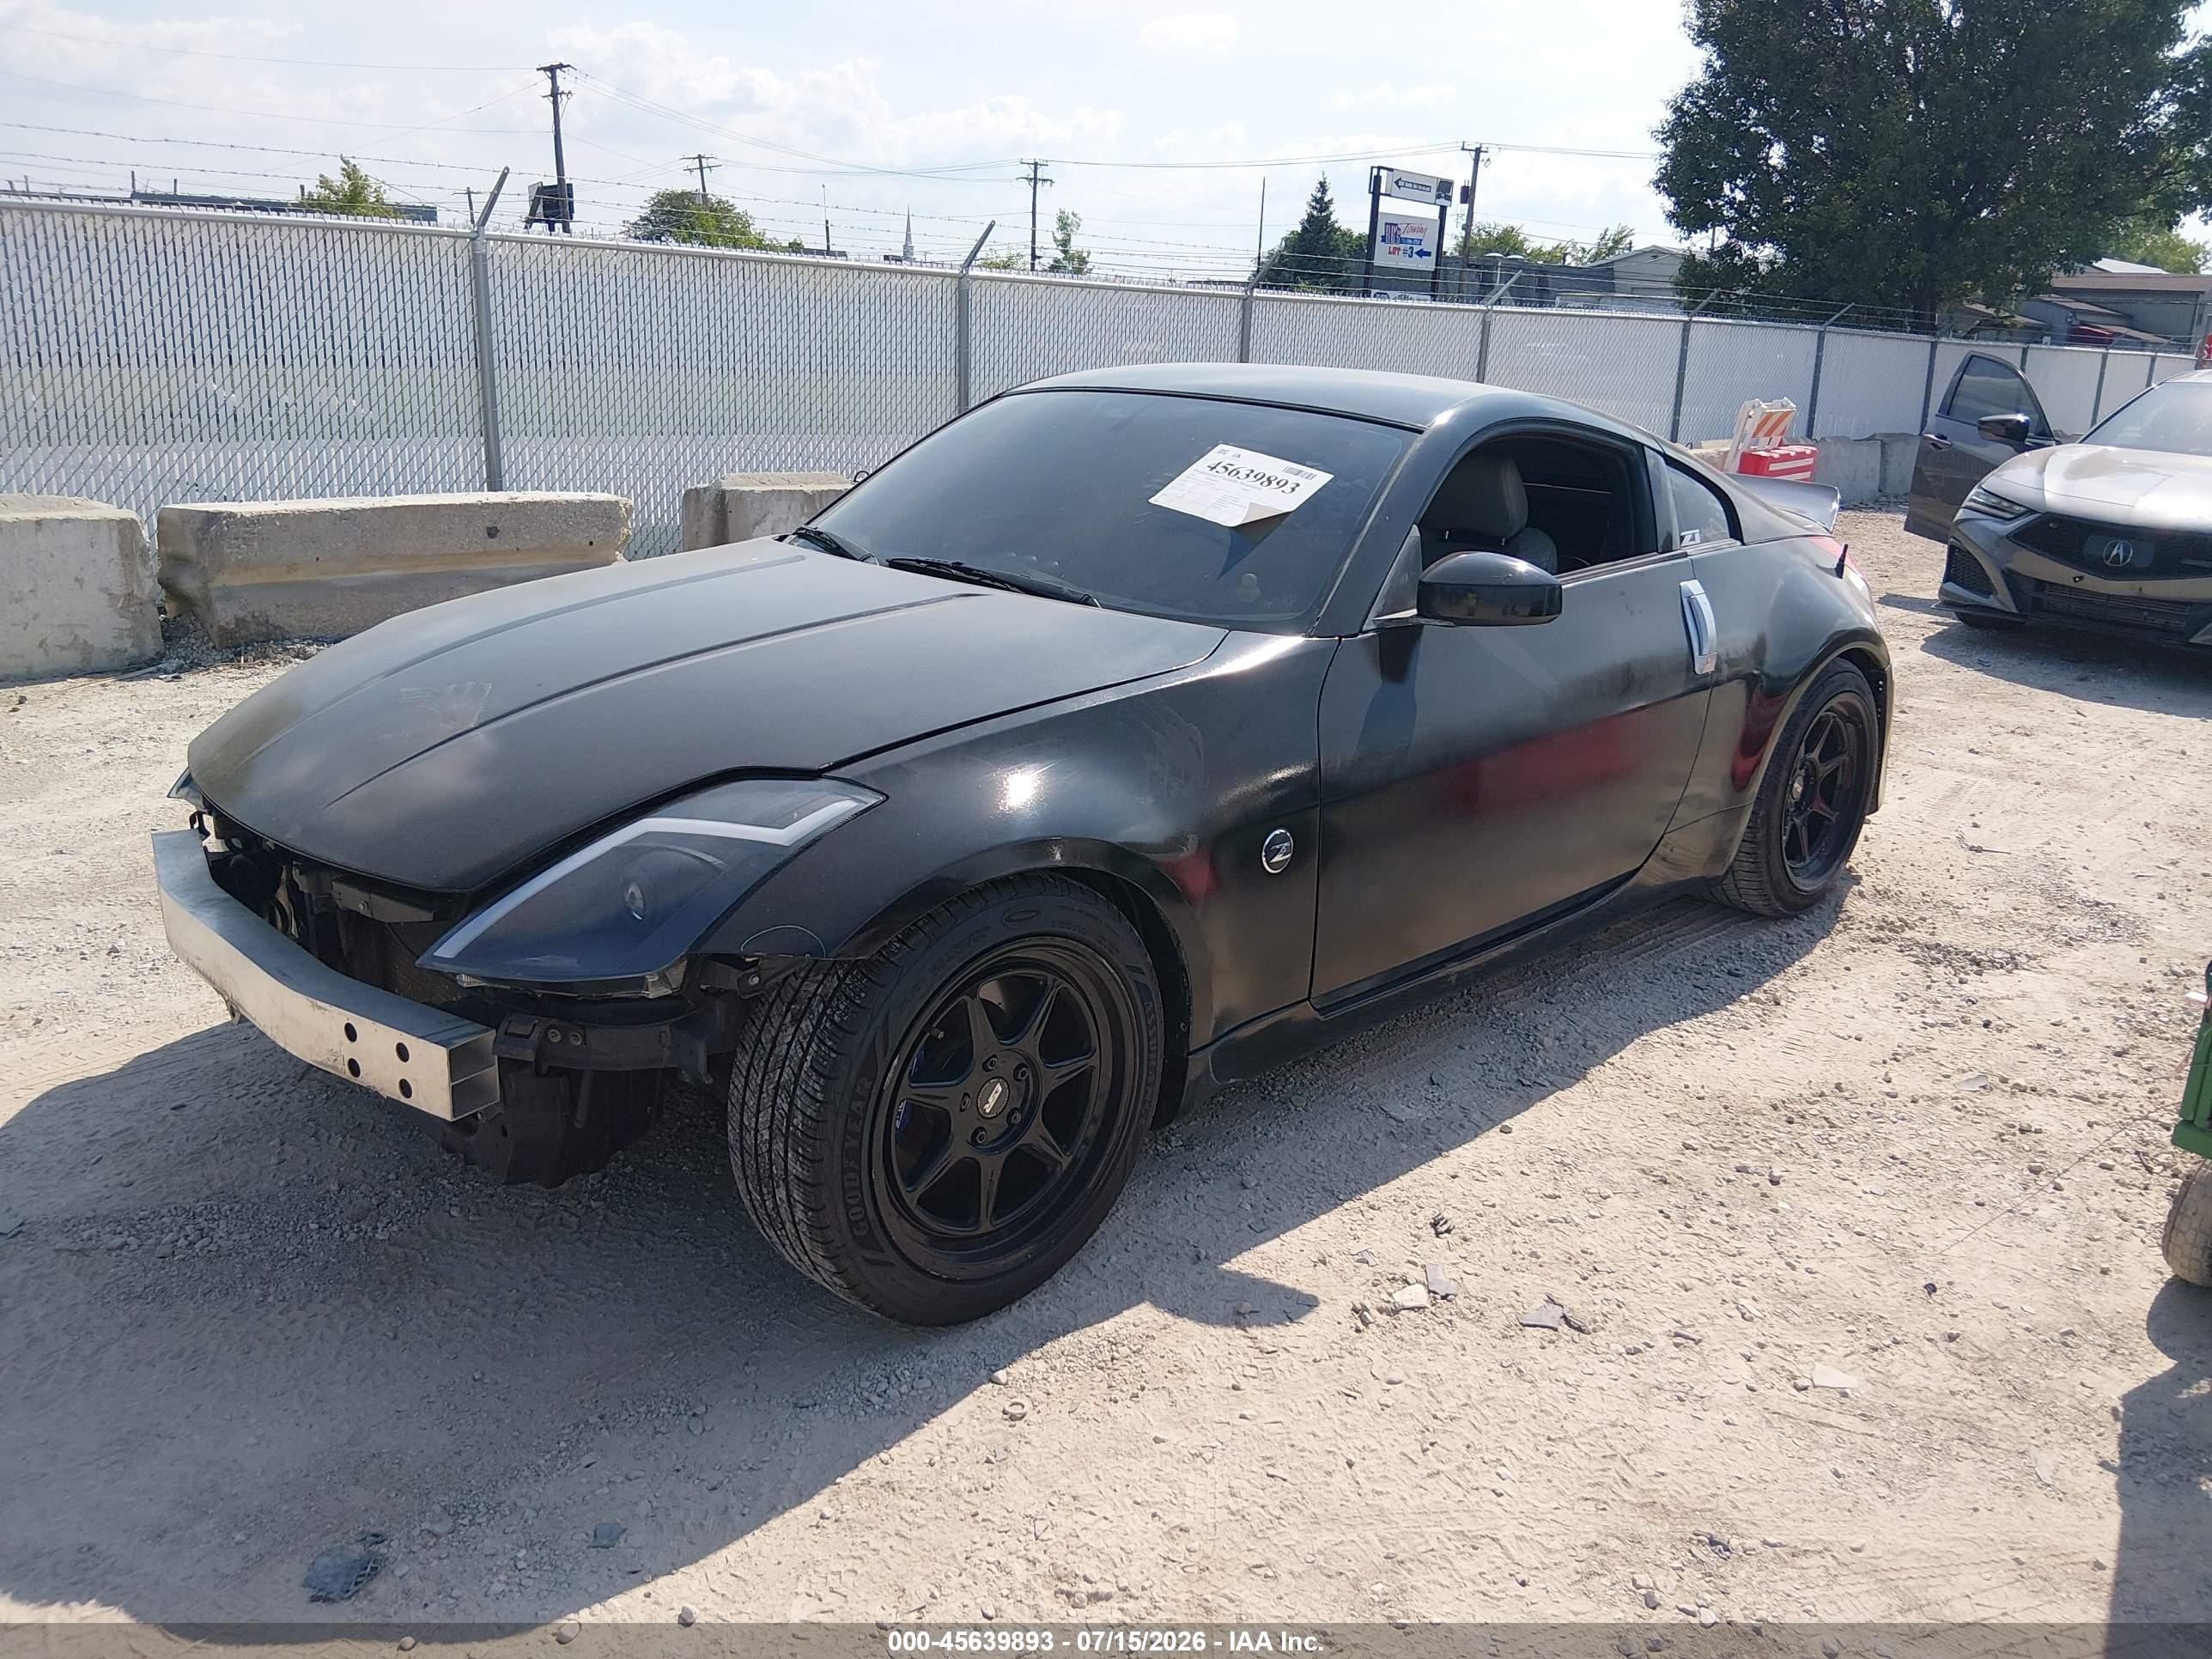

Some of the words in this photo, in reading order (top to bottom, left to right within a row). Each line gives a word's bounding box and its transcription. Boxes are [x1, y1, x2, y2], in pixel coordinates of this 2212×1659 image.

[1400, 222, 1429, 238] Towing
[1388, 246, 1401, 256] LOT
[1401, 246, 1414, 258] #3
[1206, 460, 1301, 495] 45639893
